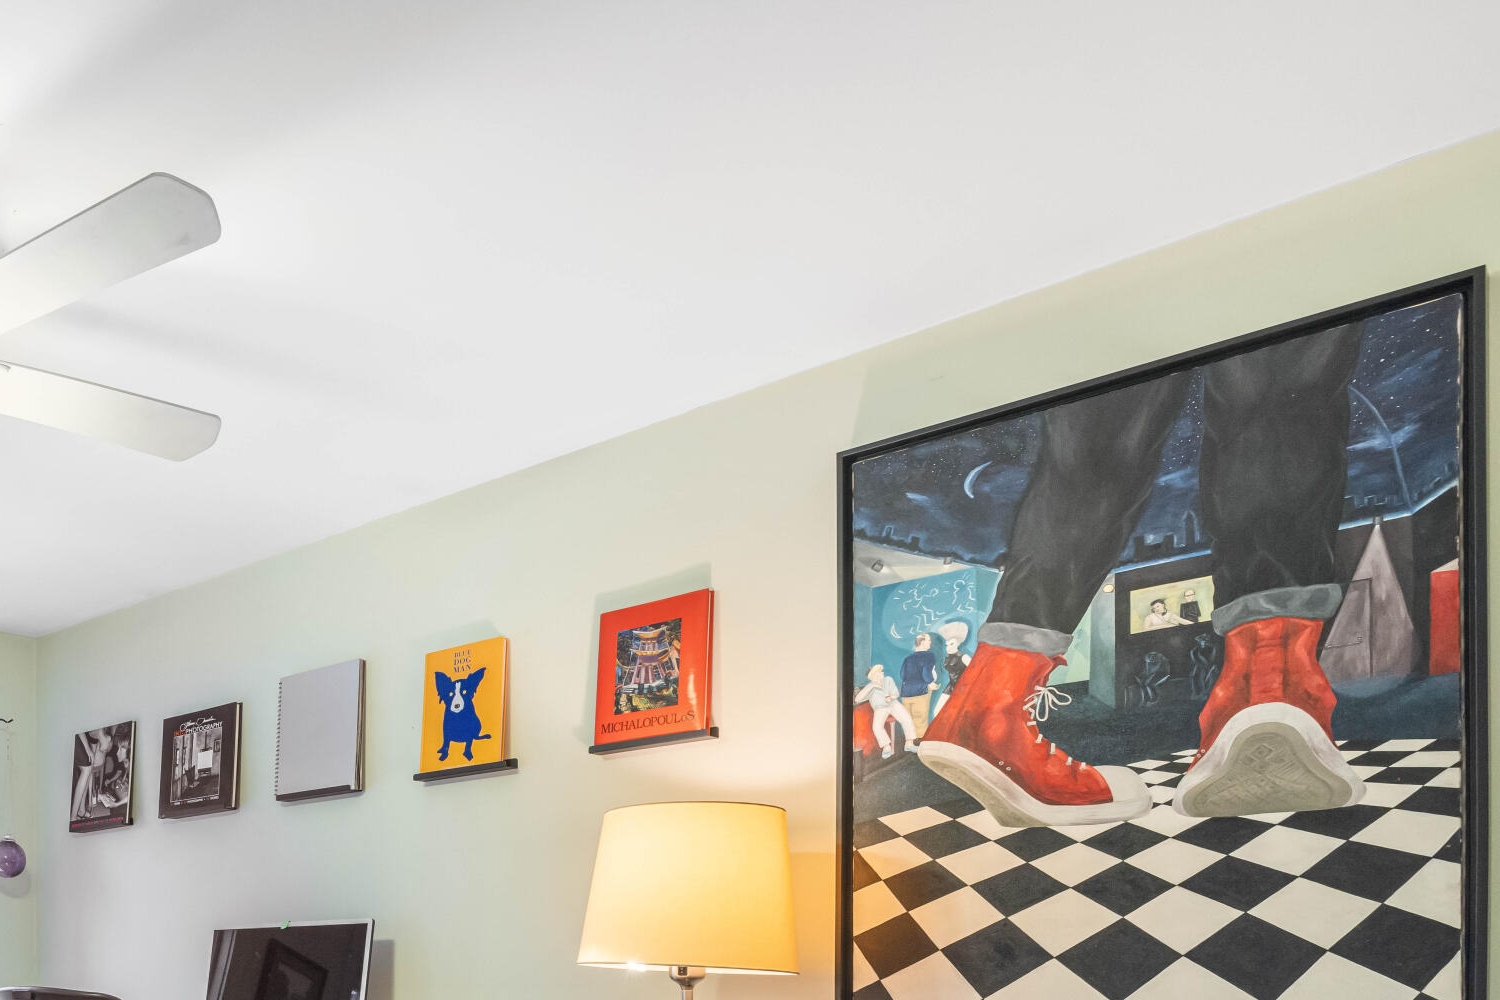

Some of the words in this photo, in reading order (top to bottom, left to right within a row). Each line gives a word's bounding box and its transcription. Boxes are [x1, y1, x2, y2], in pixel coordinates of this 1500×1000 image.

[454, 649, 472, 658] BLUE
[453, 656, 472, 666] DOG
[453, 664, 472, 673] MAN
[600, 710, 695, 735] MICHALOPOULOS
[186, 721, 223, 735] PHOTOGRAPHY
